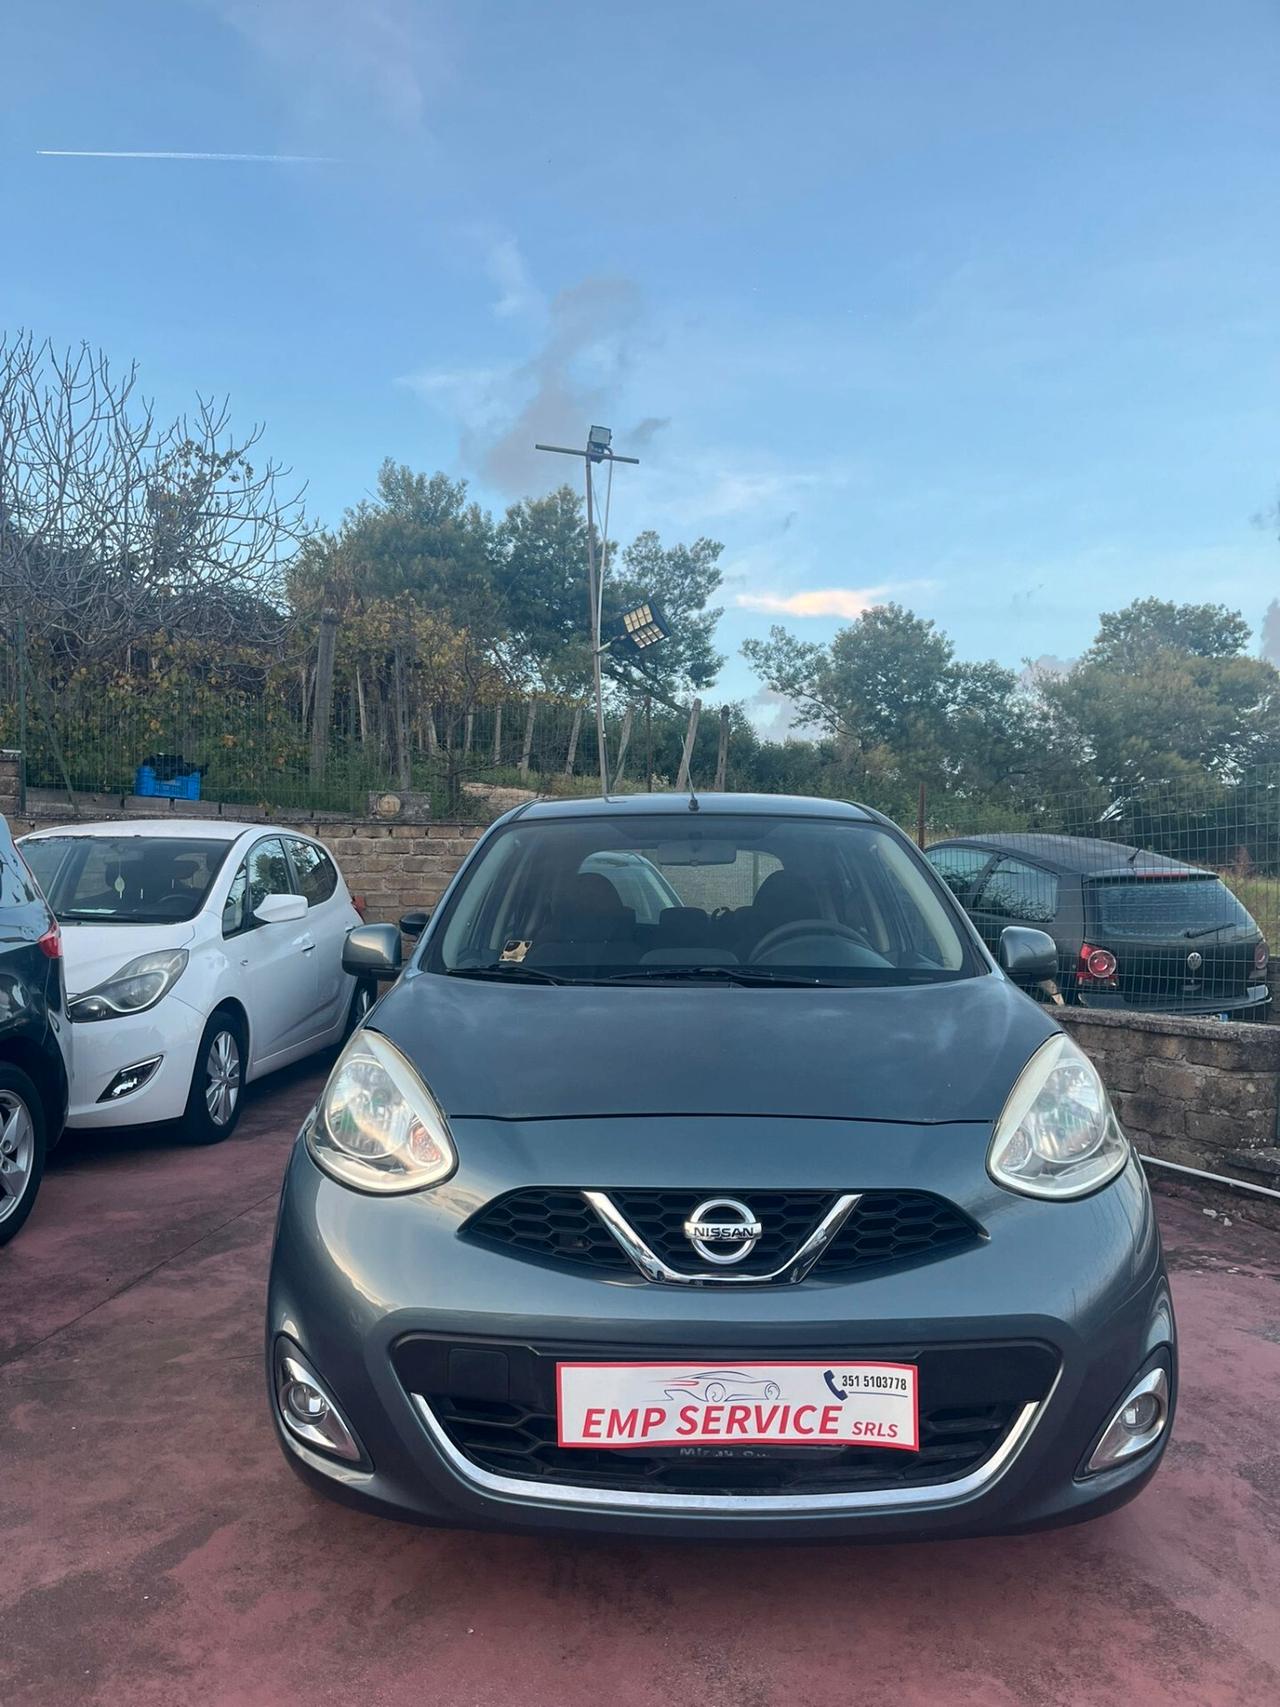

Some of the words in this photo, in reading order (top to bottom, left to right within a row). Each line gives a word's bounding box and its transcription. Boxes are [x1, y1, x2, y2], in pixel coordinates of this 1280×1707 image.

[694, 1227, 754, 1238] NISSAN
[842, 1375, 860, 1387] 351
[863, 1376, 907, 1391] 5103778
[582, 1407, 667, 1439] EMP
[675, 1404, 843, 1436] SERVICE
[851, 1421, 899, 1438] SRLS
